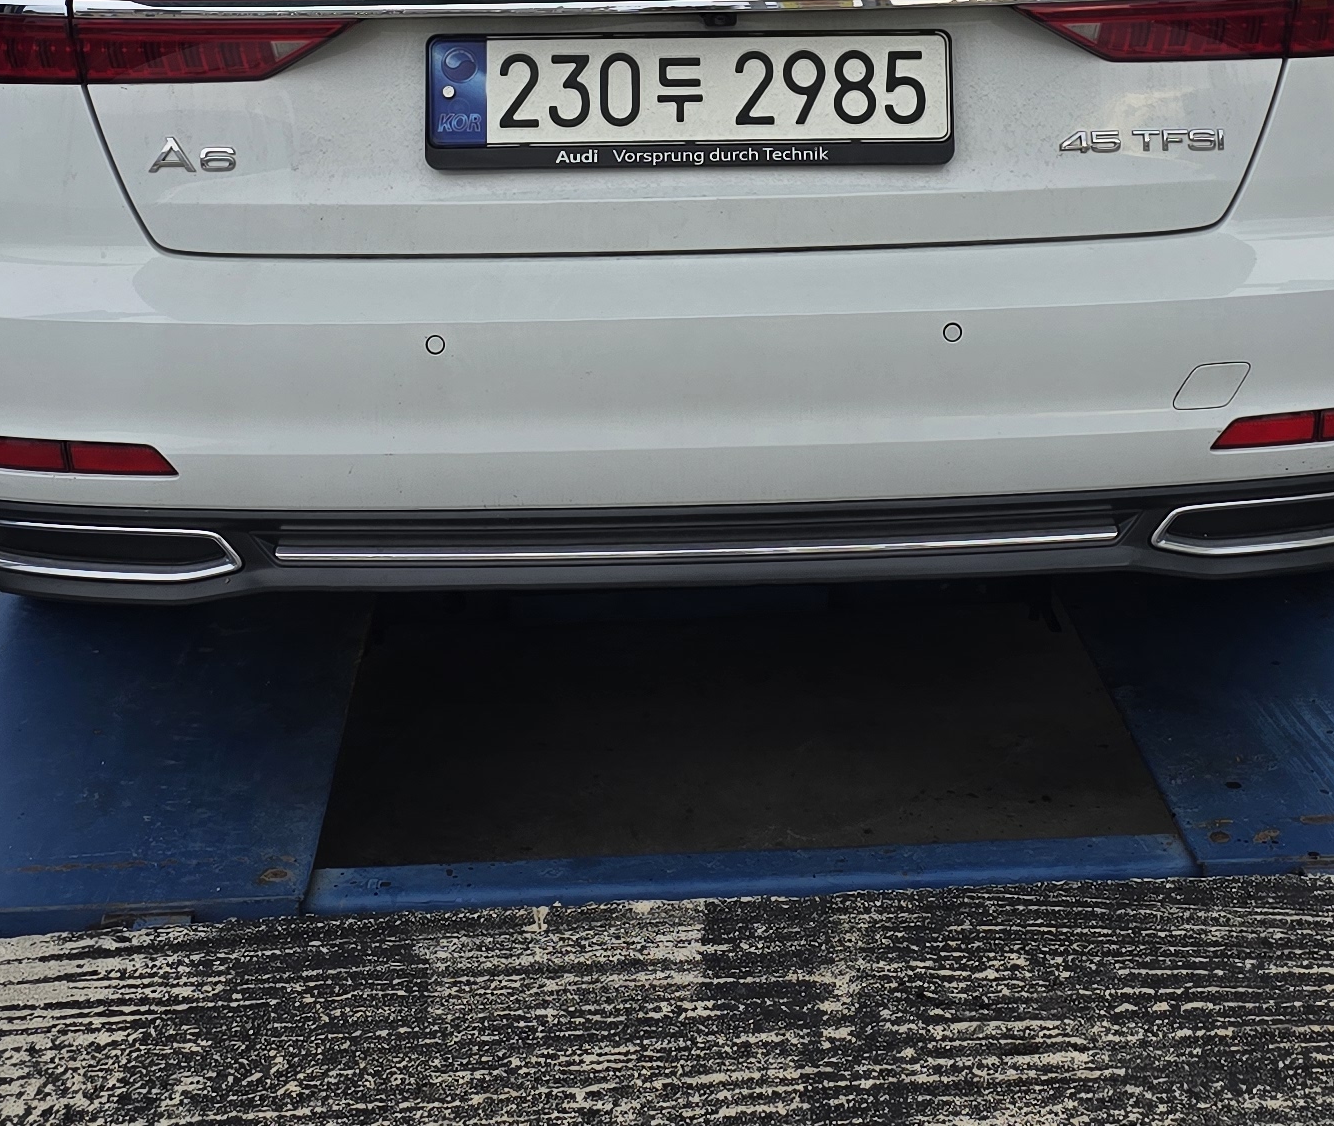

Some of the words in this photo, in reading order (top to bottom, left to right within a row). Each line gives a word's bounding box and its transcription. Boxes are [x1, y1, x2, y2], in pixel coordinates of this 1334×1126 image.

[499, 52, 704, 129] 230두
[734, 49, 927, 126] 2985
[437, 113, 482, 133] KOR
[1059, 129, 1122, 153] 45
[1131, 129, 1225, 152] TFSI
[148, 136, 237, 174] A6
[555, 149, 599, 164] Audi
[612, 149, 705, 166] Vorsprung
[708, 147, 759, 163] durch
[763, 146, 830, 162] Technik
